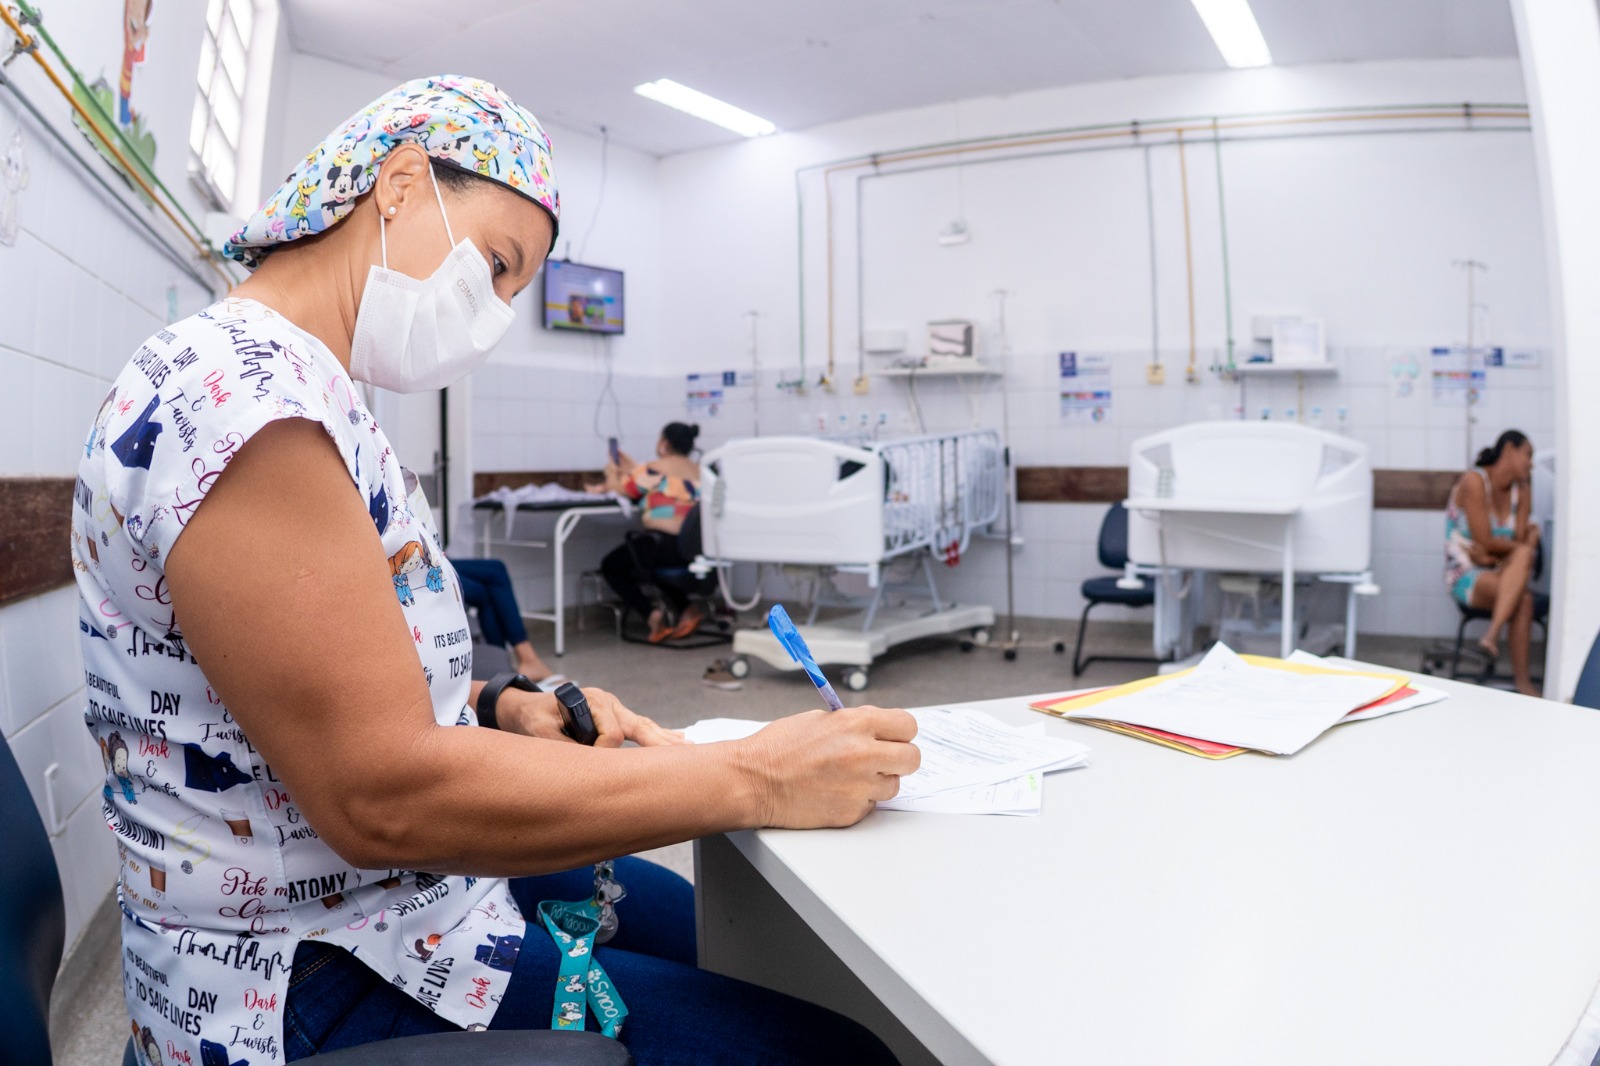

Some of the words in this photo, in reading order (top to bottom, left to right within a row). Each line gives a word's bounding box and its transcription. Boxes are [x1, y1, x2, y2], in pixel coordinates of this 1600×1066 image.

[172, 346, 199, 372] DAY
[203, 368, 231, 408] Dark
[434, 634, 446, 649] ITS
[449, 656, 460, 679] TO
[150, 690, 181, 716] DAY
[139, 734, 171, 758] Dark
[220, 867, 268, 896] Pick
[135, 976, 147, 1002] TO
[148, 987, 169, 1020] SAVE
[170, 1003, 202, 1036] LIVES
[188, 986, 218, 1014] DAY
[244, 988, 277, 1012] Dark
[416, 986, 442, 1012] AVE
[465, 977, 491, 1010] Dark
[253, 1013, 265, 1031] &
